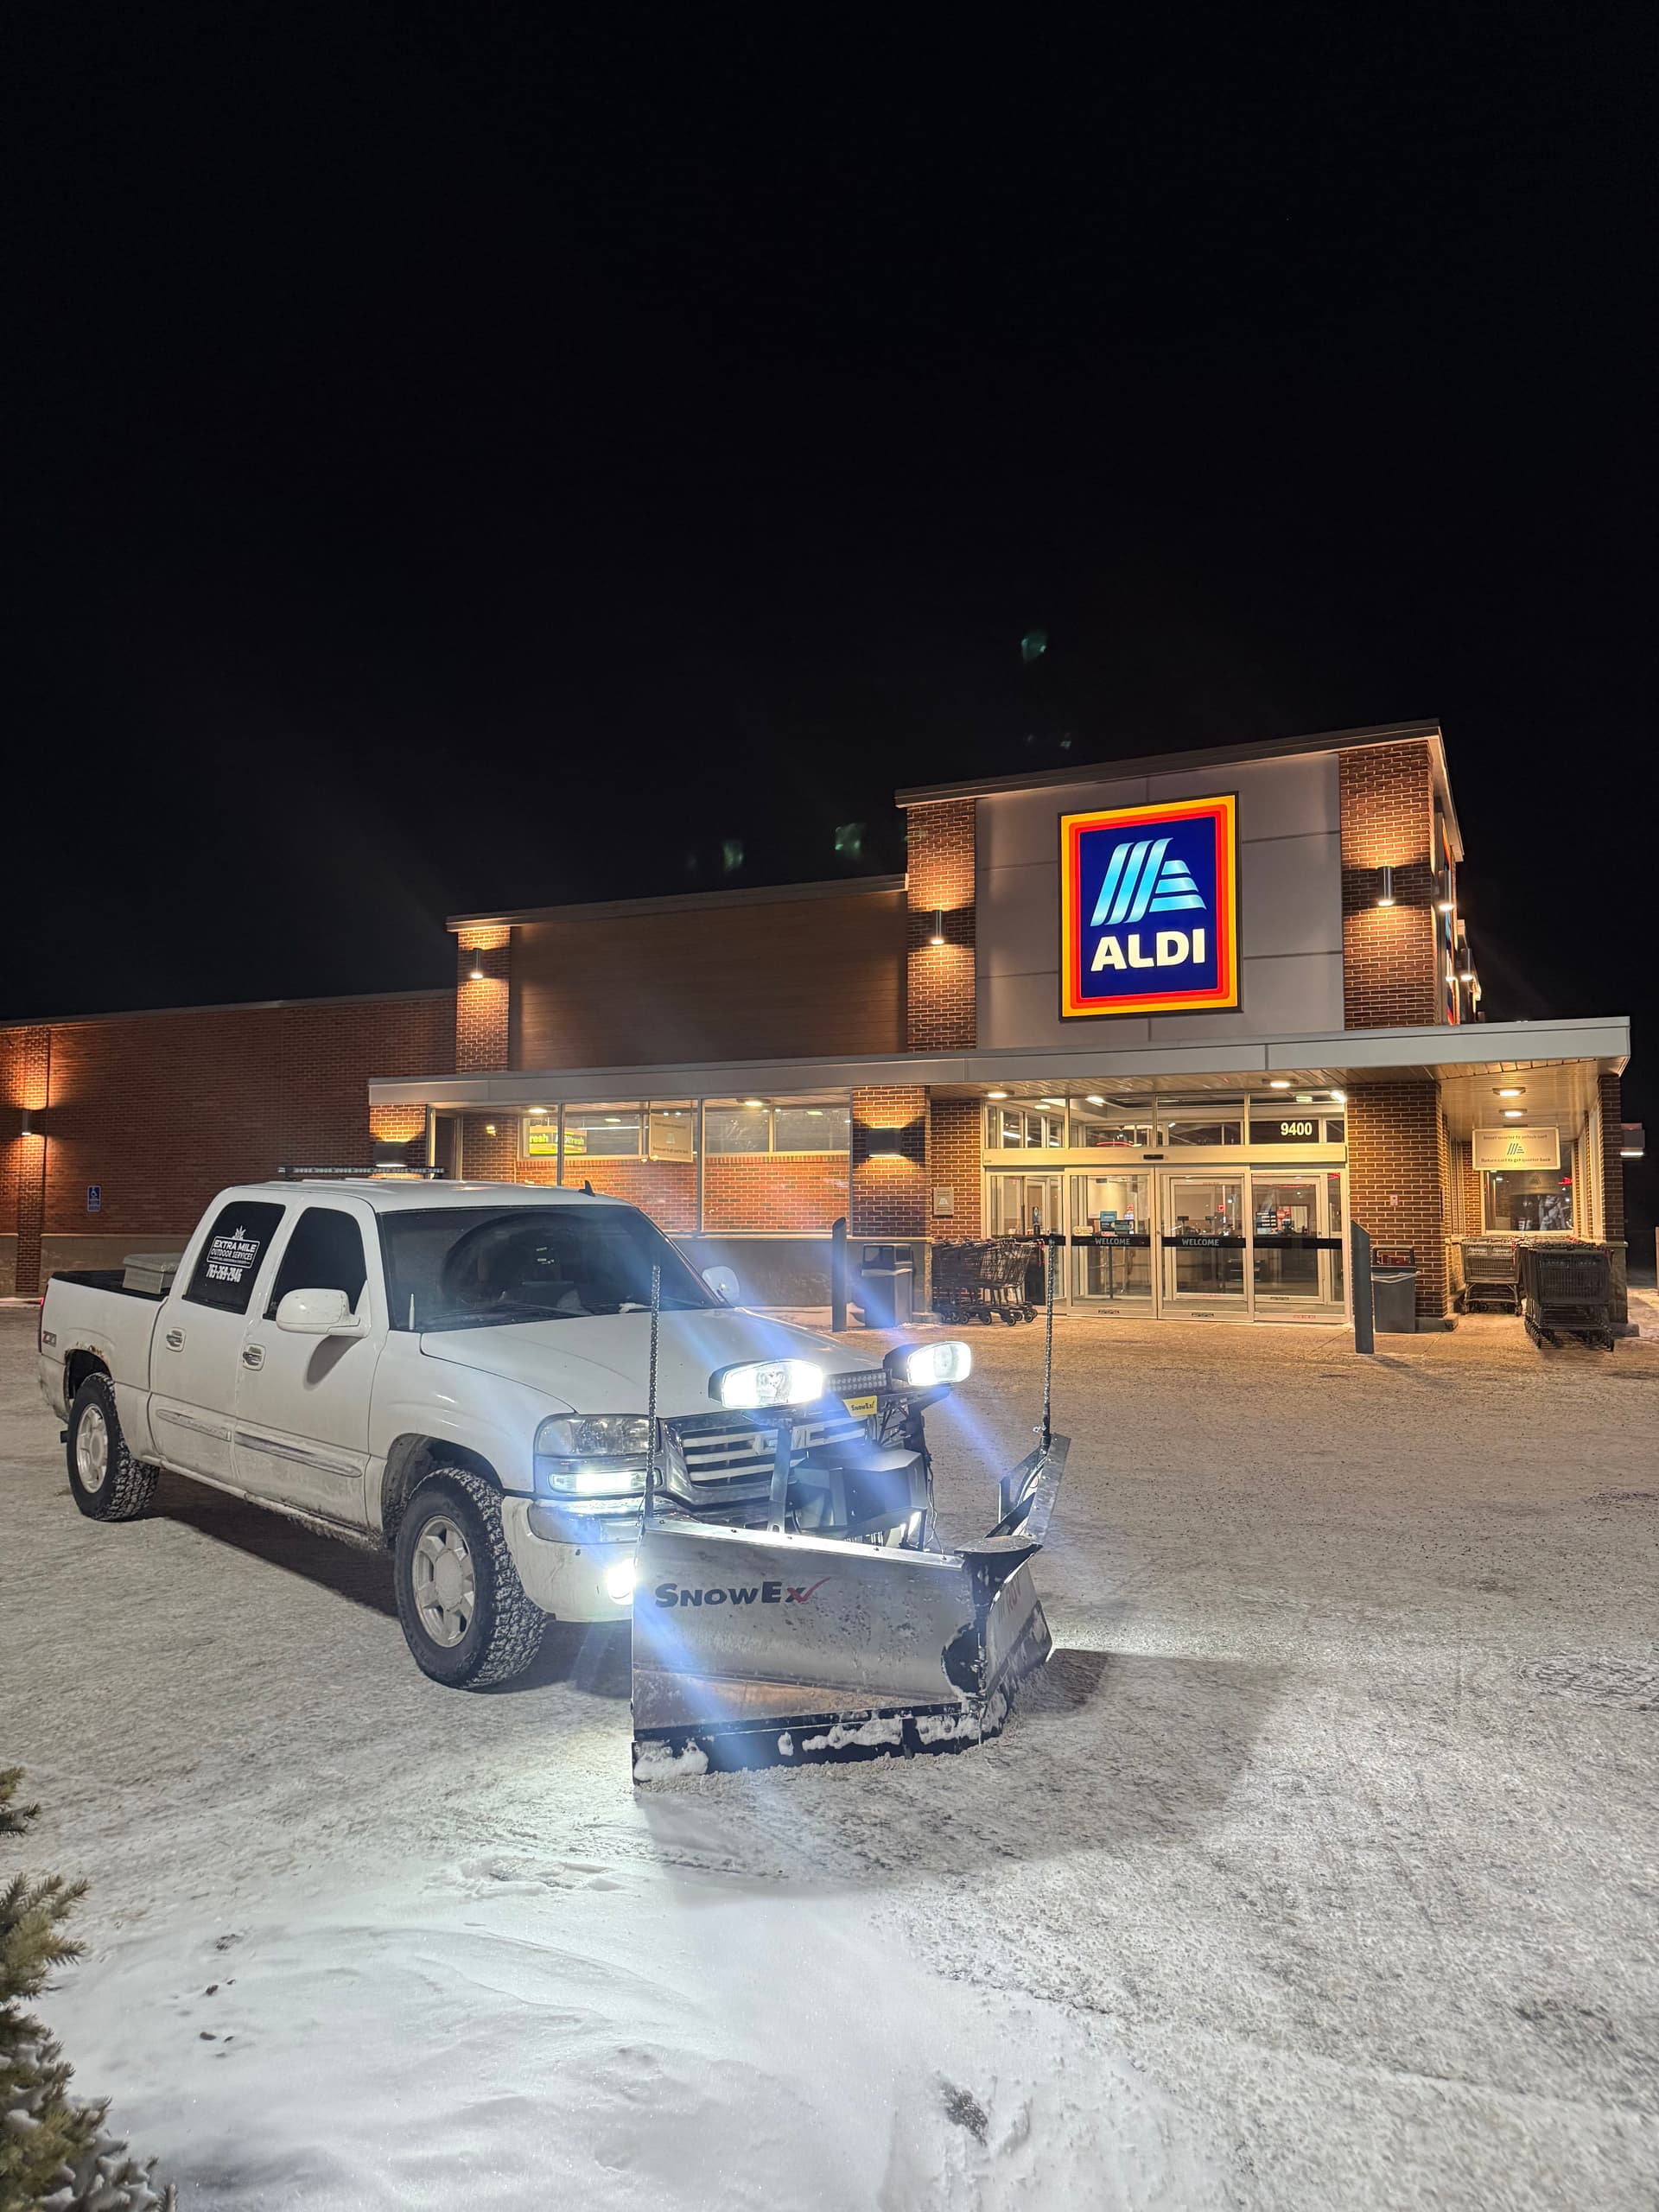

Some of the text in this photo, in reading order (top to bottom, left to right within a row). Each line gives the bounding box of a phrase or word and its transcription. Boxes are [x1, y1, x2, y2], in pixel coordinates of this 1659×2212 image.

[1090, 928, 1205, 972] ALDI
[1281, 1122, 1313, 1136] 9400
[213, 1239, 257, 1252] EXTRA MILE
[211, 1248, 232, 1258] OUTDOOR
[232, 1250, 253, 1261] SERVICES
